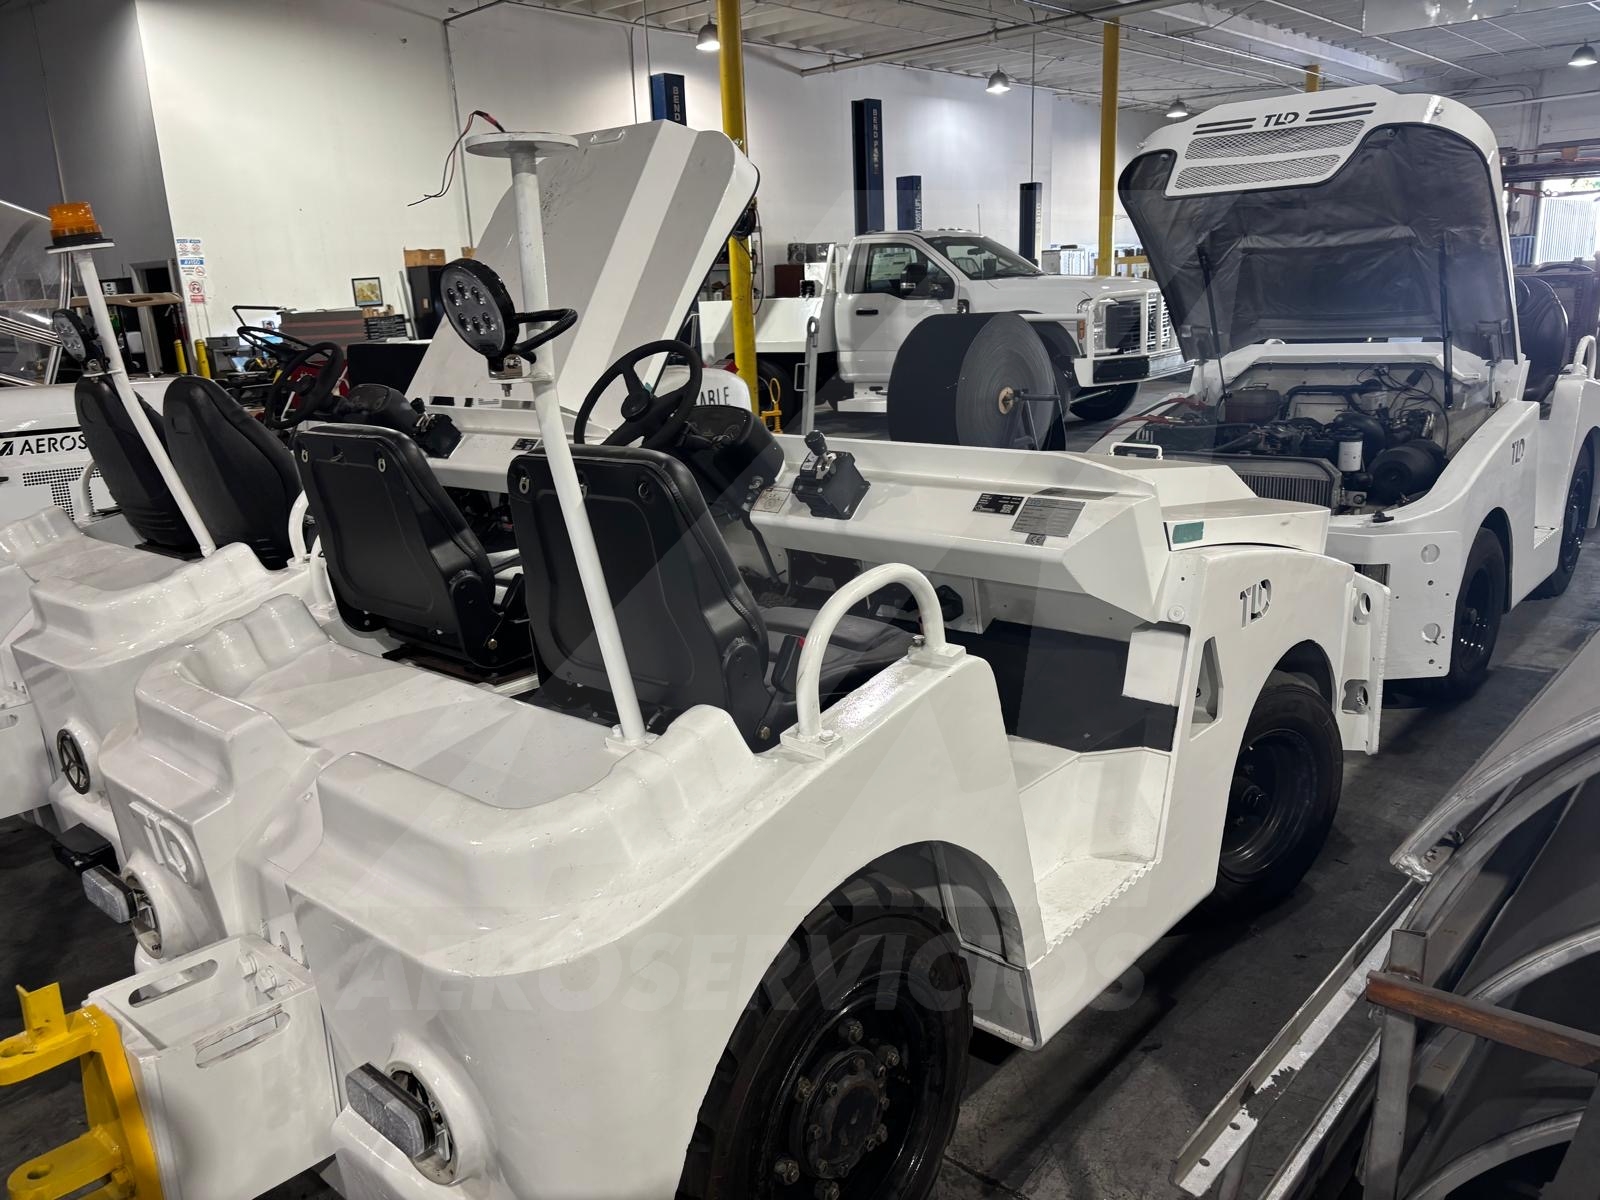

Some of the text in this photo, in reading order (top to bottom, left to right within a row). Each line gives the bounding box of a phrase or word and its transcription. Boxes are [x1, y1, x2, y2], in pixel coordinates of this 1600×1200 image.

[673, 86, 681, 121] BEND
[1264, 112, 1299, 128] TLD
[1511, 438, 1525, 465] TLD
[1239, 578, 1271, 628] TLD
